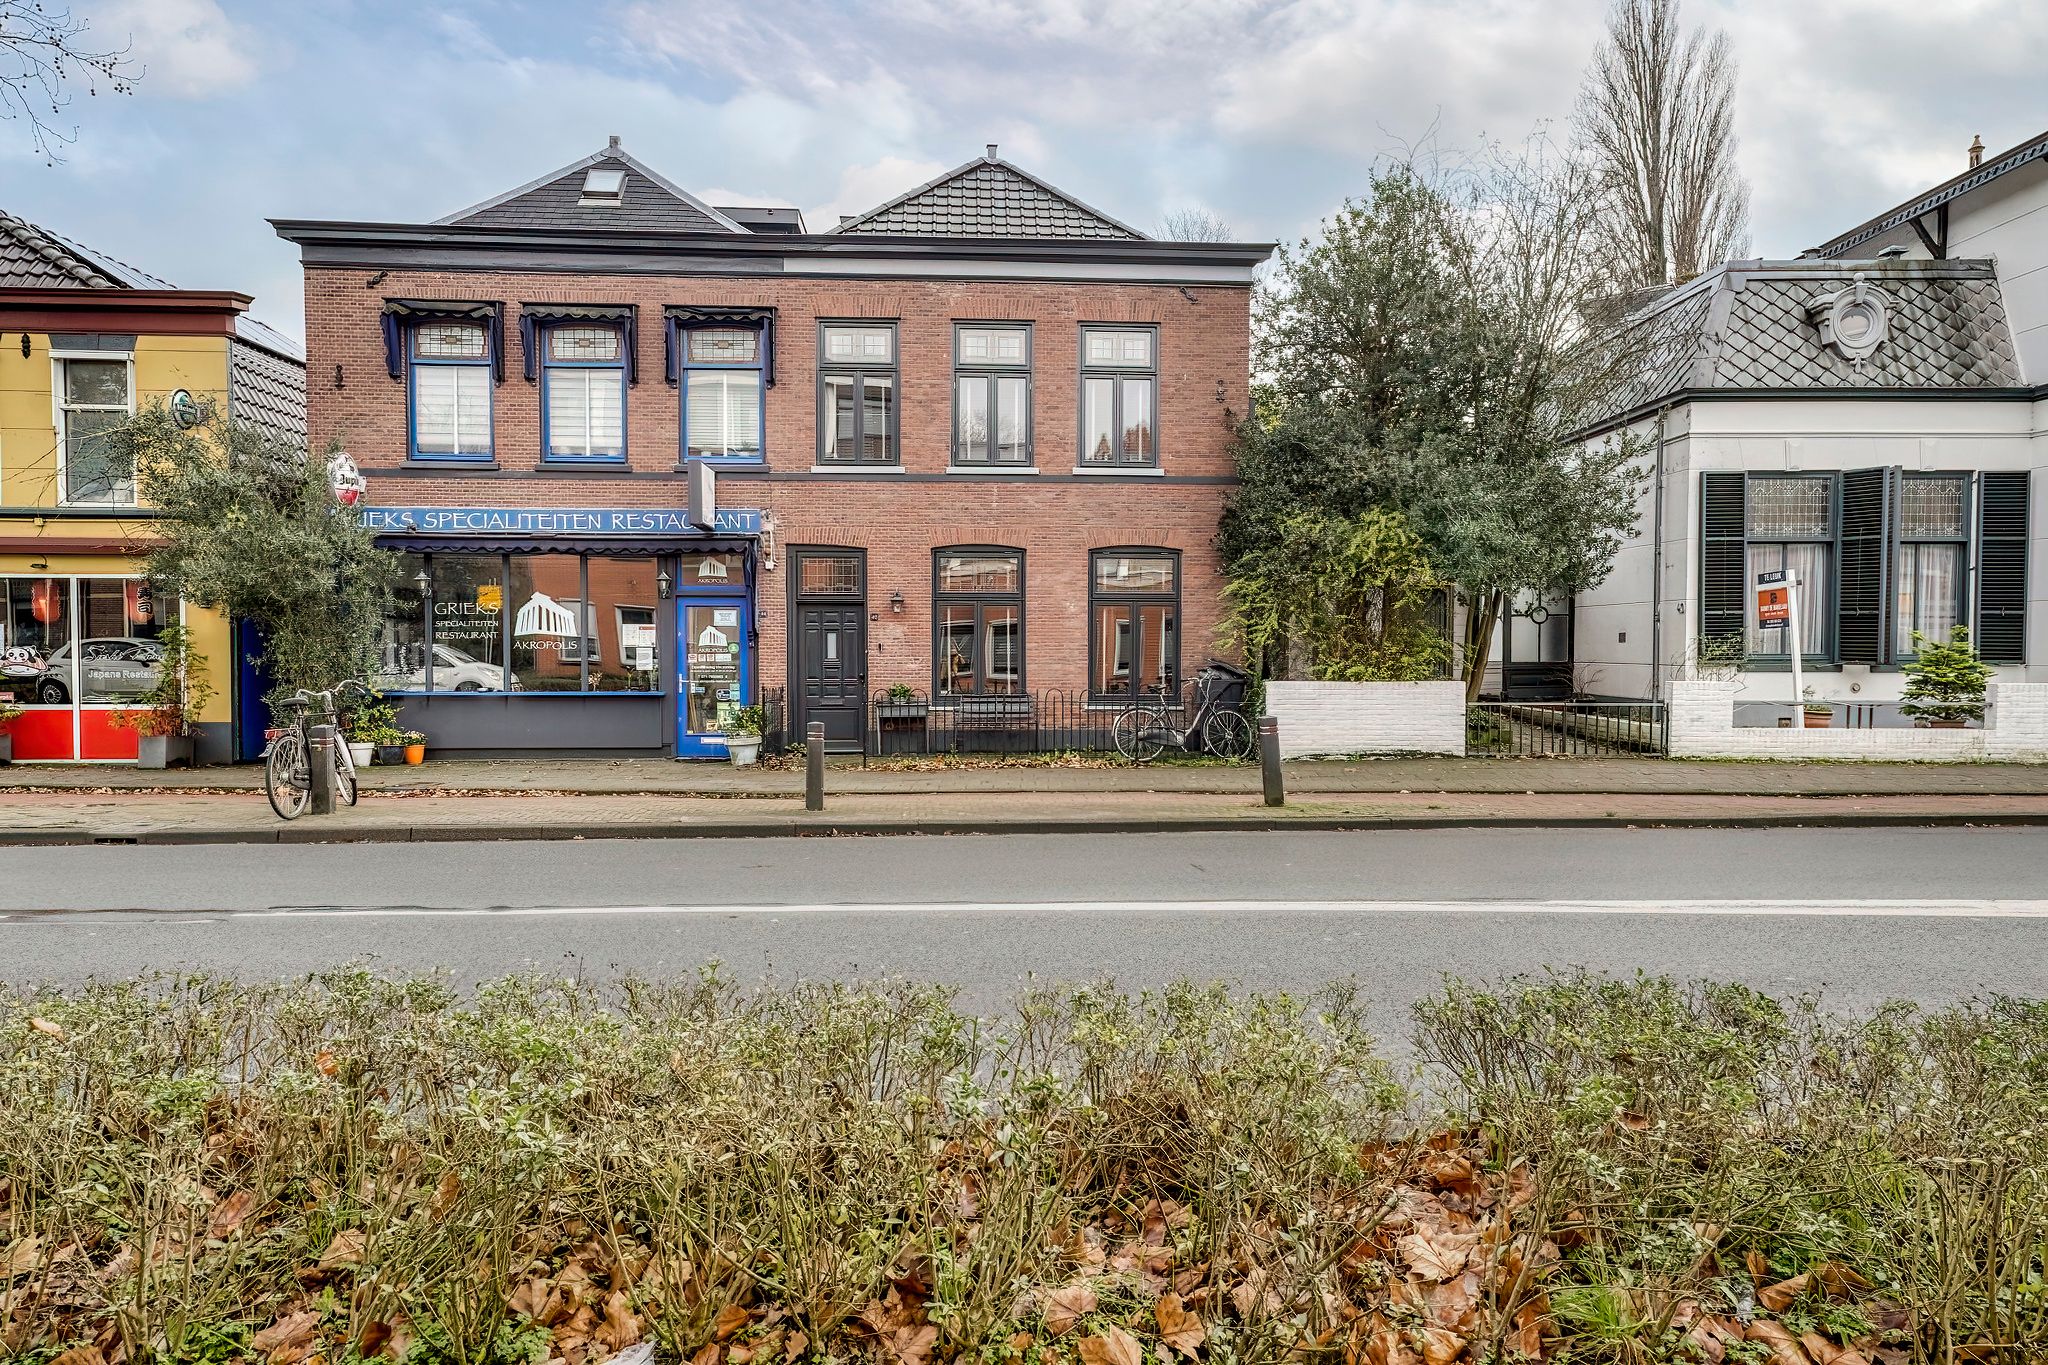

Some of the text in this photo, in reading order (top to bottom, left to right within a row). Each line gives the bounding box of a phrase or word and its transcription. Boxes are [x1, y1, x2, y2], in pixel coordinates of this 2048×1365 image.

[357, 511, 757, 530] IEKS SPECIALITEITEN RESTAUANT
[434, 602, 499, 615] GRIEKS
[435, 631, 499, 639] RESTAURANT
[513, 640, 578, 650] AKROPOLIS
[122, 670, 160, 679] Restaur
